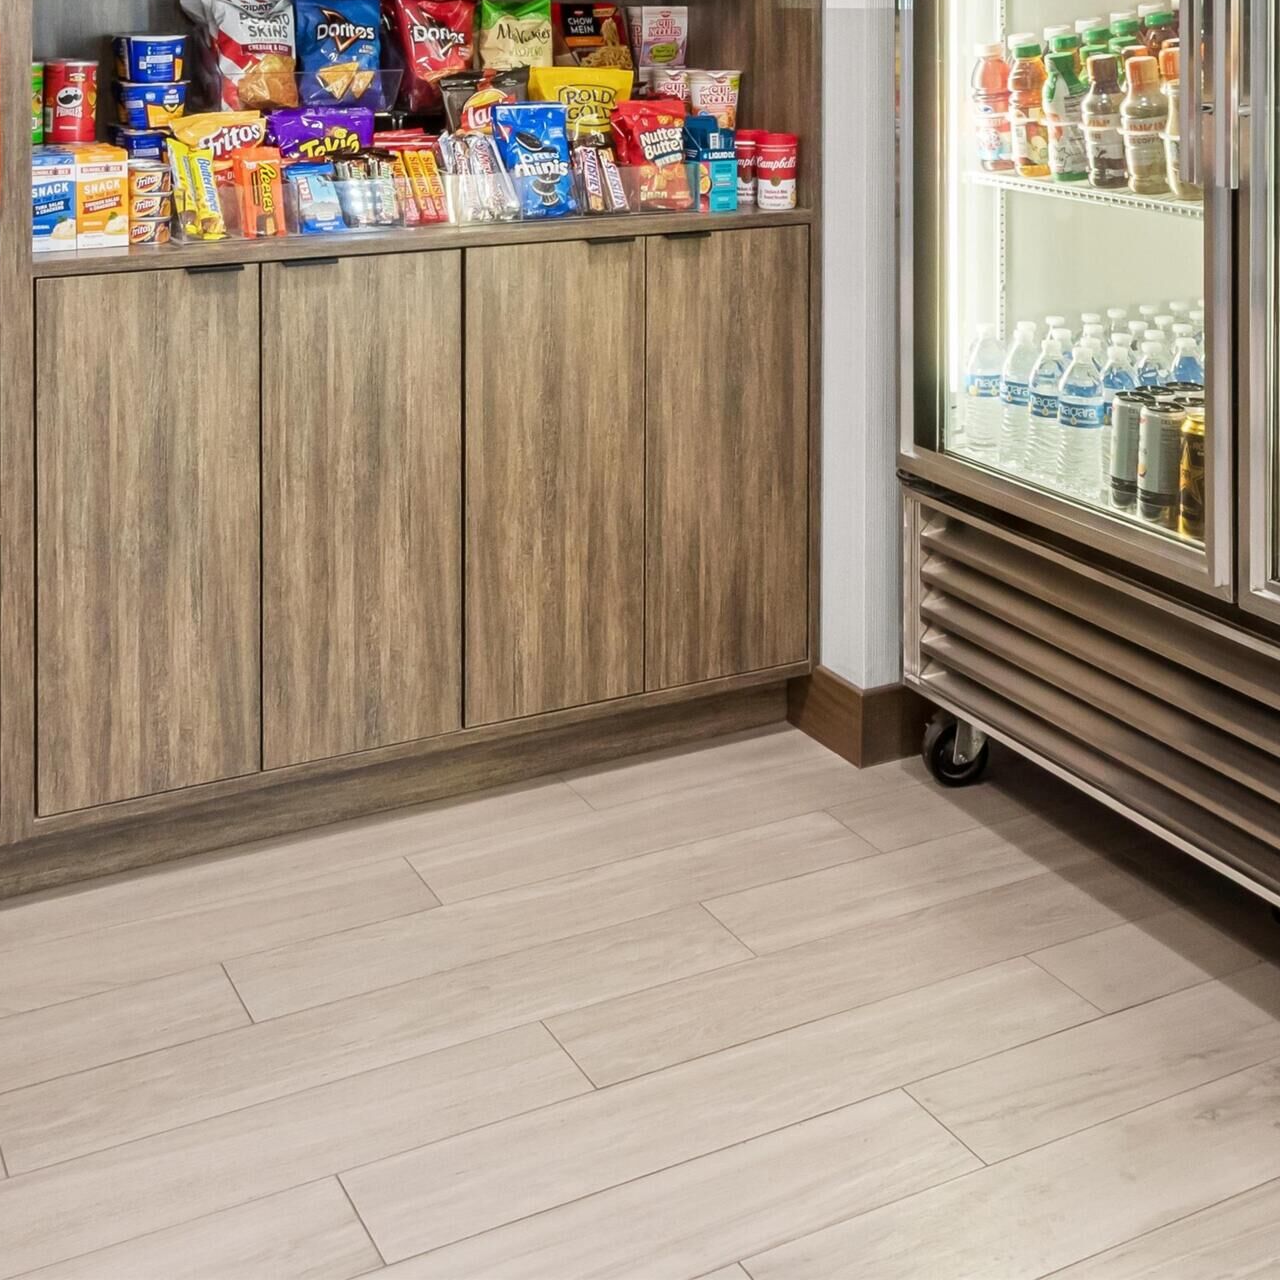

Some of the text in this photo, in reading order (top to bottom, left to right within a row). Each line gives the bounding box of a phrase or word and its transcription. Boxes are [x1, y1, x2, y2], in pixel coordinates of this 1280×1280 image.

[568, 17, 593, 26] CHOW
[248, 24, 288, 39] SKINS
[316, 22, 375, 52] Doritos
[570, 25, 594, 34] MEIN
[565, 90, 615, 105] ROLD
[640, 127, 682, 145] Nutter
[645, 140, 684, 160] Butter
[516, 159, 568, 177] minis
[756, 157, 797, 169] Campbell's
[32, 183, 69, 198] SNACK
[84, 179, 121, 193] SNACK
[197, 158, 218, 214] Butterfinger
[259, 162, 277, 212] Reese's
[1058, 405, 1097, 418] niagara
